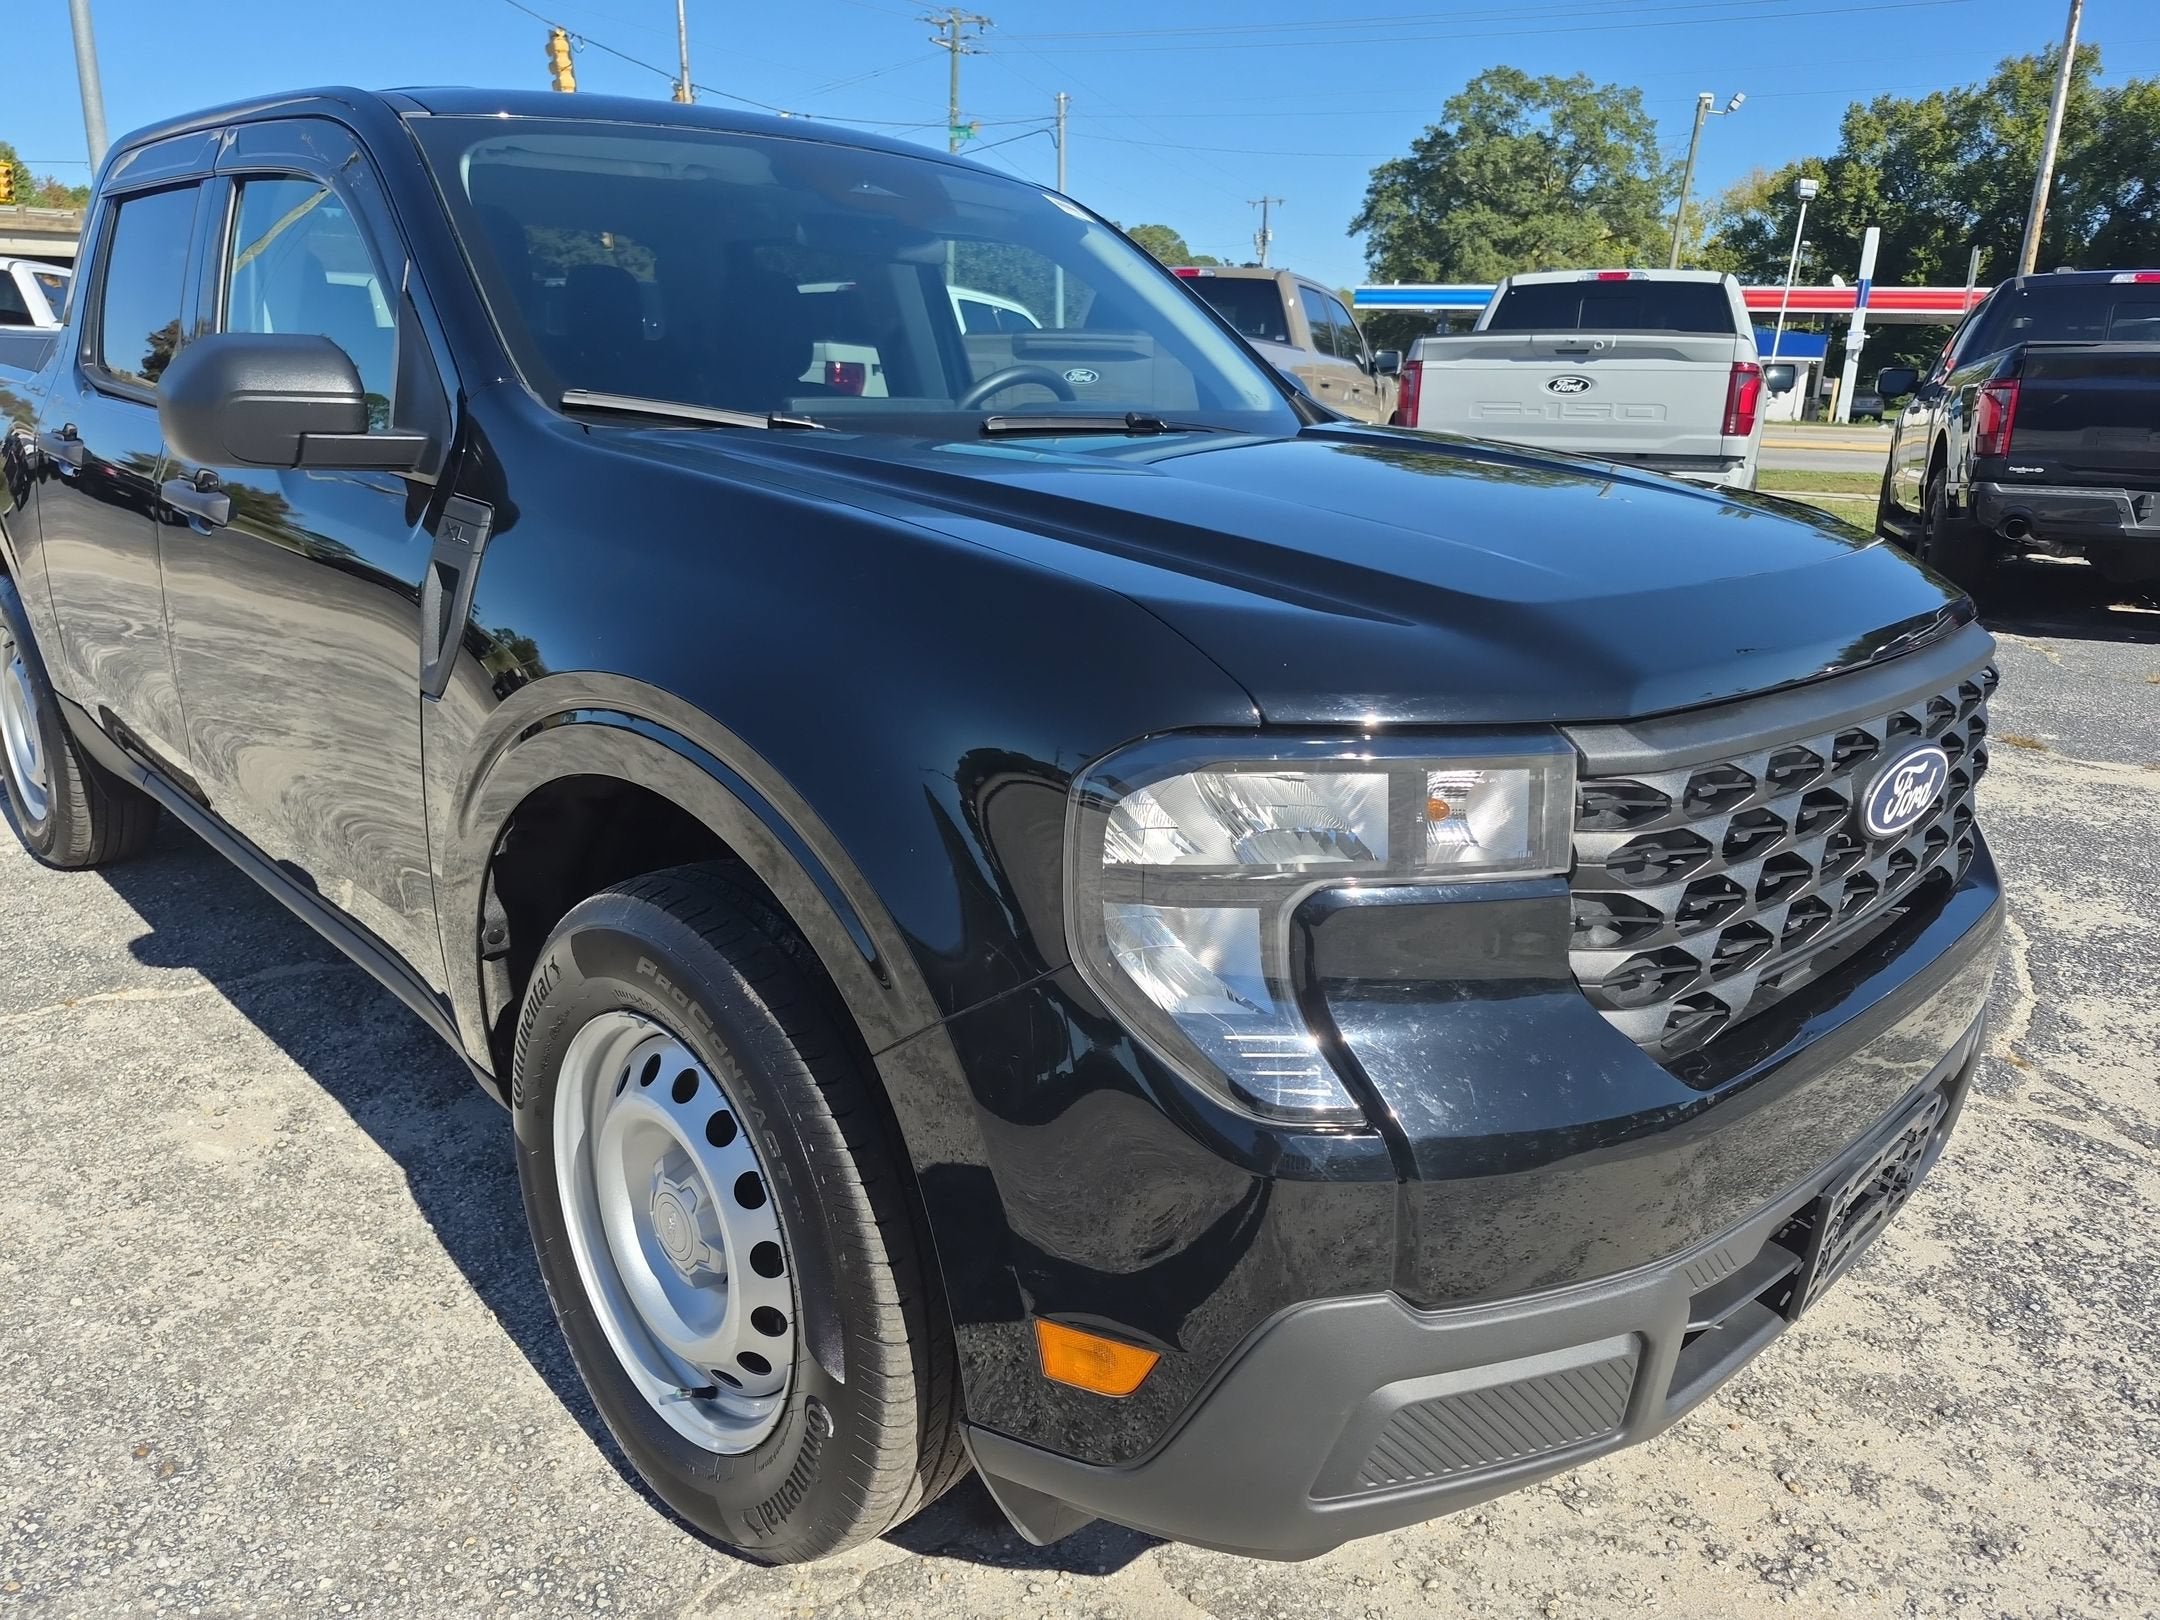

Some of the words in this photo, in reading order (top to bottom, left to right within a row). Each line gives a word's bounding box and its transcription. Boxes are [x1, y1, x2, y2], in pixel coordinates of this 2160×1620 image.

[1069, 371, 1093, 382] Ford
[1553, 378, 1585, 392] Ford
[1467, 402, 1667, 422] F-150
[441, 521, 470, 545] XL
[1883, 760, 1937, 824] Ford
[512, 964, 554, 1110] Continental
[755, 1394, 835, 1536] Continental
